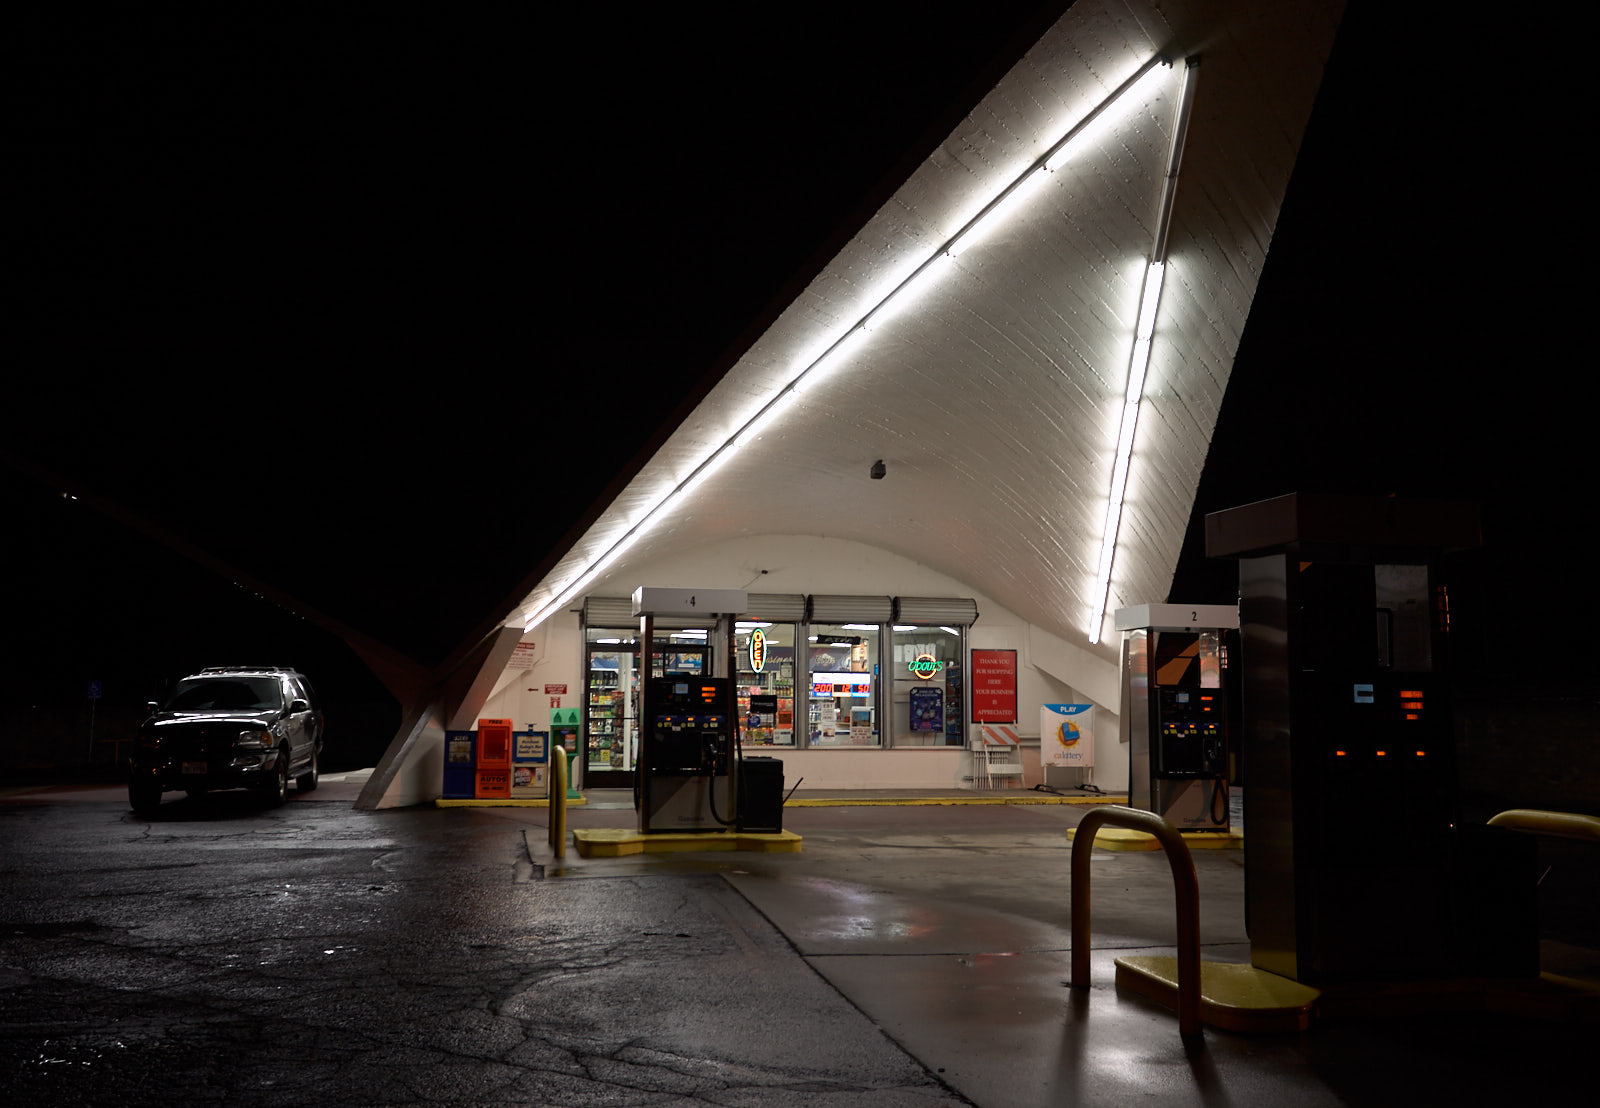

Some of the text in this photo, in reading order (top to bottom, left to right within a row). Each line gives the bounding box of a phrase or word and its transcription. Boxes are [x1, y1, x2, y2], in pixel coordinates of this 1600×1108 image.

[690, 597, 696, 607] 4
[1191, 611, 1198, 622] 2
[753, 631, 763, 669] OPEN
[814, 683, 832, 693] 200
[841, 684, 851, 693] 12
[857, 684, 869, 693] 50
